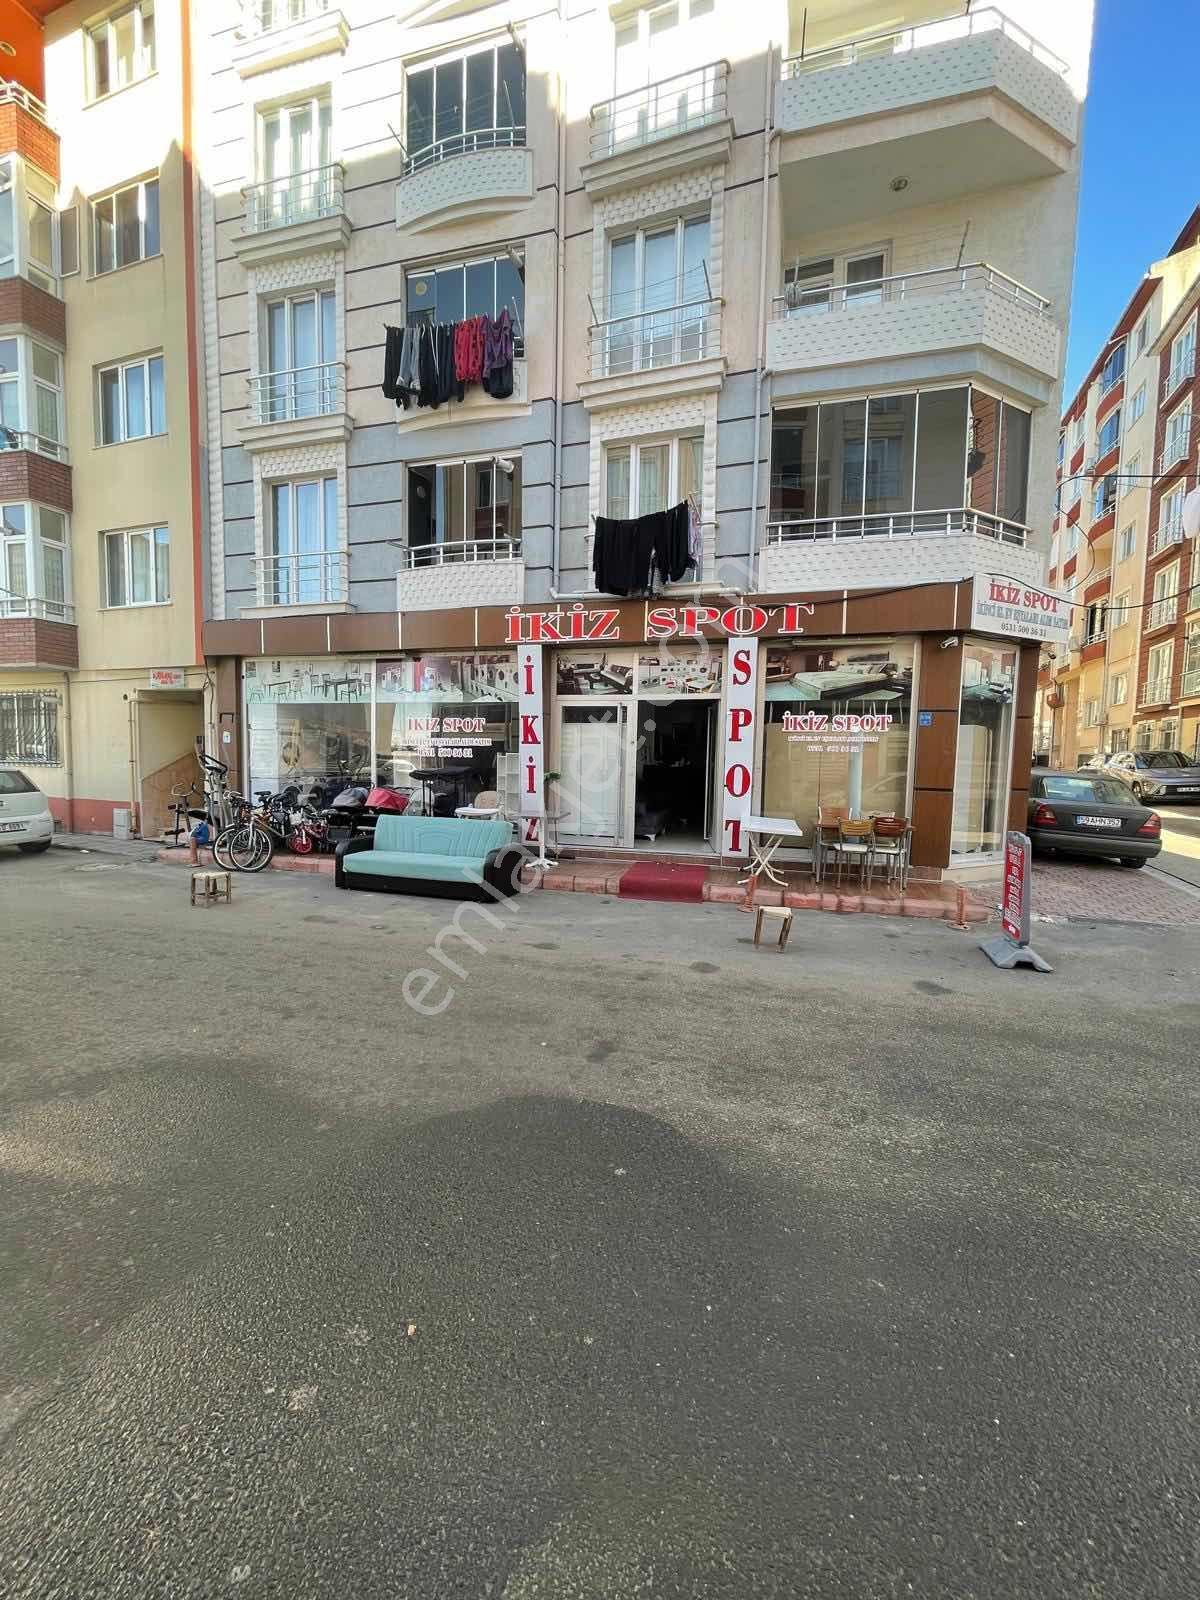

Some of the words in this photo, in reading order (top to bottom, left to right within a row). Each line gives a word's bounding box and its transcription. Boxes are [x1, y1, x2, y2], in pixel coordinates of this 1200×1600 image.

[989, 578, 1020, 605] İKİZ
[1024, 590, 1060, 613] SPOT
[504, 602, 621, 644] İKİZ
[646, 602, 815, 639] SPOT
[442, 716, 486, 733] SPOT
[782, 710, 829, 732] İKİZ
[832, 714, 893, 733] SPOT
[725, 649, 753, 853] SPOT
